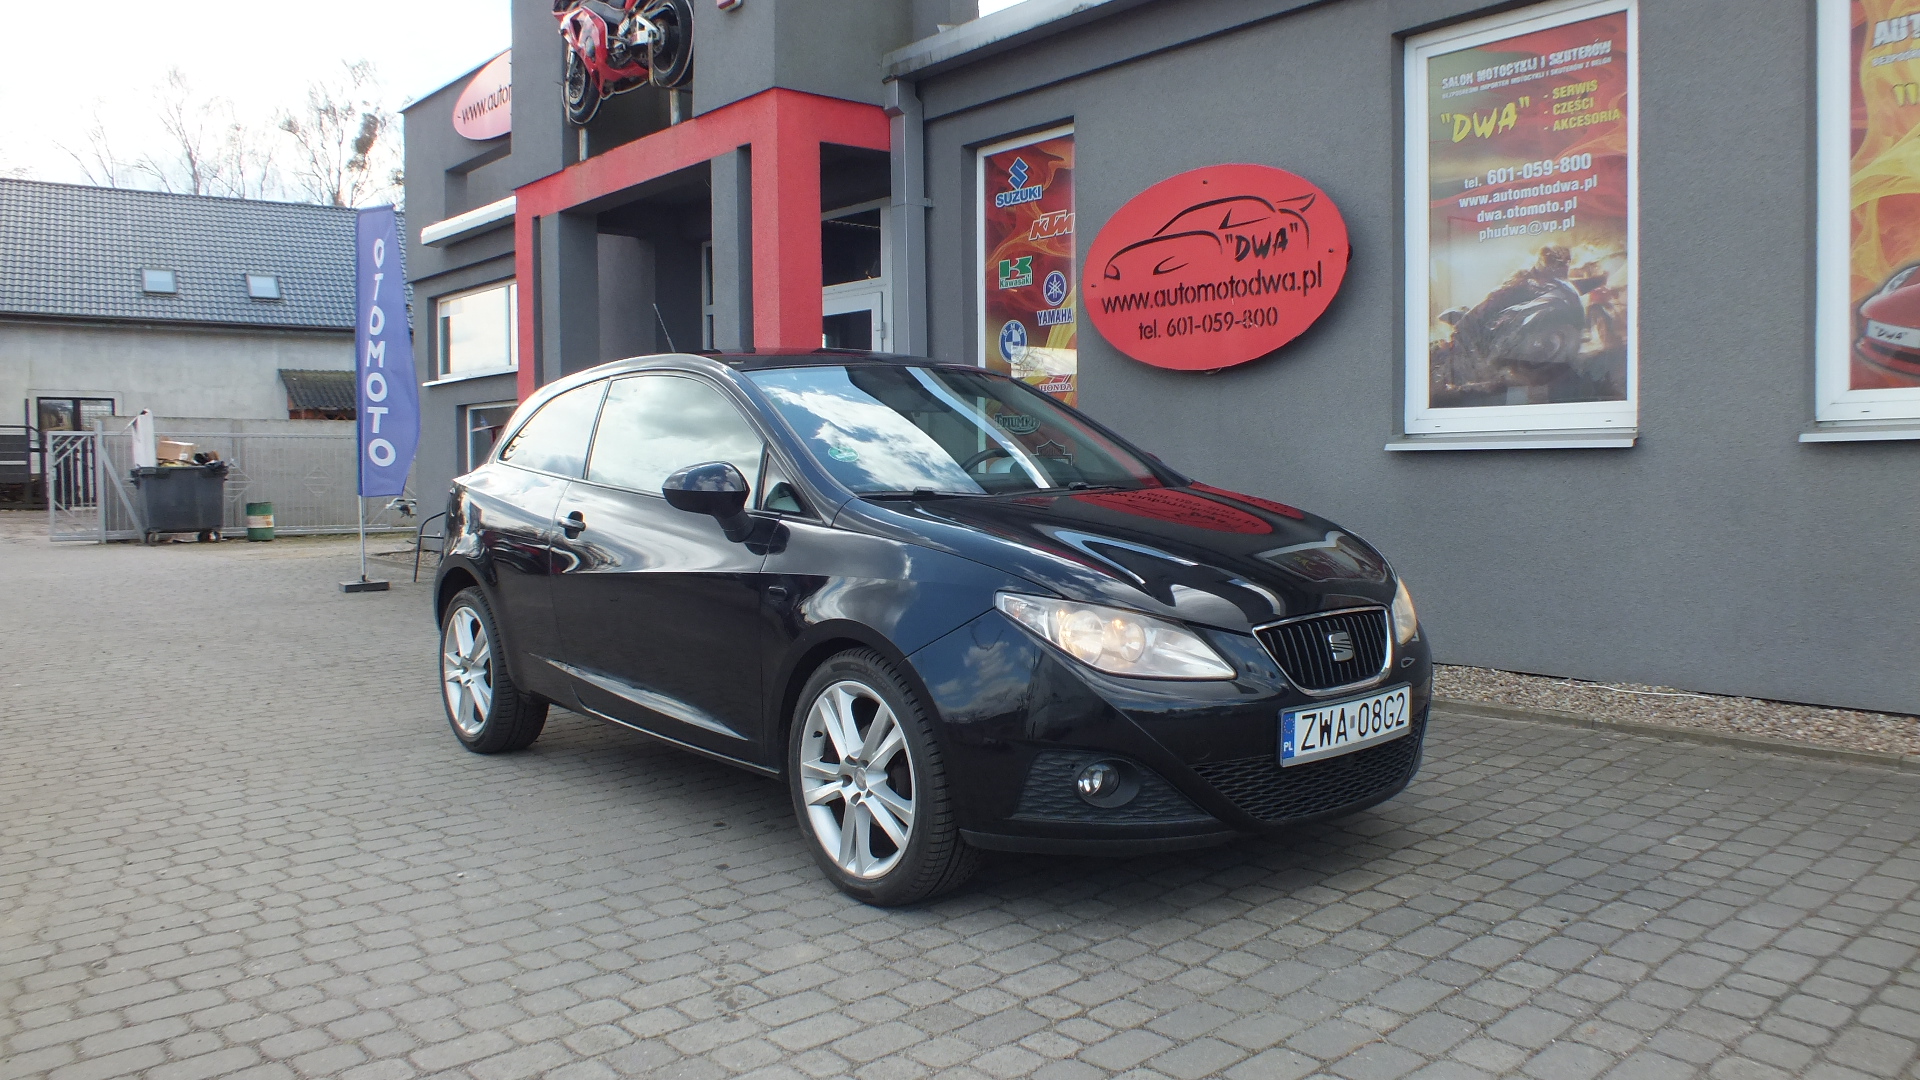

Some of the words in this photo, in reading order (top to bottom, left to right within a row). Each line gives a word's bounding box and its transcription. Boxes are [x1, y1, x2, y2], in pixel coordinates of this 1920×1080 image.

[1442, 71, 1473, 89] SALON
[1477, 57, 1538, 82] MOTOCYKLI
[1541, 55, 1546, 68] I
[1549, 38, 1612, 66] SKUTERÓW
[462, 84, 512, 124] www.auto
[1552, 79, 1598, 99] SERWIS
[1440, 96, 1530, 144] "DWA"
[1552, 97, 1594, 116] CZĘŚCI
[1552, 108, 1621, 132] AKCESORIA
[1464, 177, 1482, 189] tel.
[1487, 152, 1592, 186] 601-059-800
[996, 185, 1042, 207] SUZUKI
[1459, 174, 1597, 208] www.automotodwa.pl
[1029, 210, 1075, 240] KTM
[1477, 196, 1577, 222] dwa.otomoto.pl
[1225, 222, 1298, 263] "DWA"
[1479, 215, 1575, 242] phudwa@vp.pl
[999, 274, 1032, 288] Kawasaki
[1101, 261, 1322, 314] www.automotodwa.pl
[1037, 308, 1073, 326] YAMAHA
[1139, 318, 1161, 341] tel.
[1167, 306, 1278, 338] 601-059-800
[366, 237, 396, 467] OTOMOTO
[1040, 383, 1073, 392] HONDA
[1283, 741, 1293, 751] PL
[1300, 708, 1348, 751] ZWA
[1357, 692, 1405, 737] 08G2
